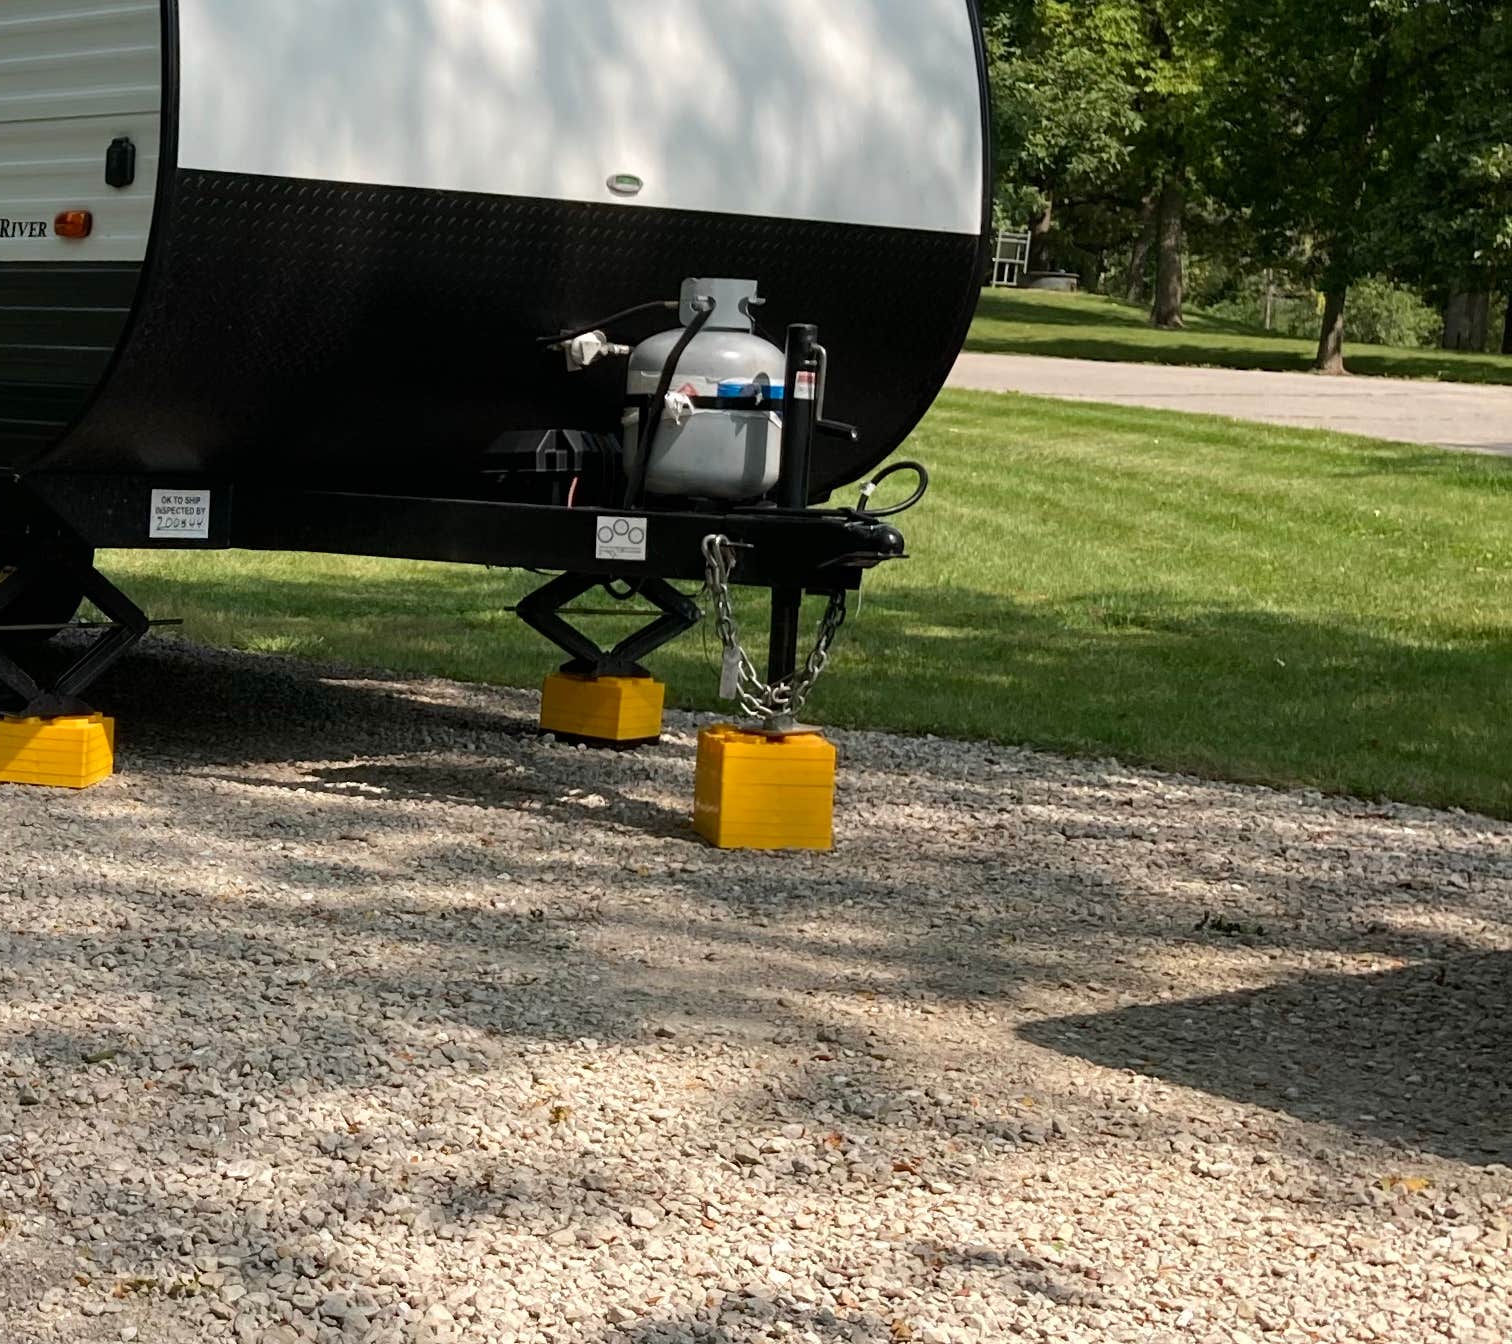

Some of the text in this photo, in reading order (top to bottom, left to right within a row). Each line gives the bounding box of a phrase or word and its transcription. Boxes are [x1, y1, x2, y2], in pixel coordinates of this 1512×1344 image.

[161, 496, 201, 505] OK TO SHIP
[155, 506, 206, 515] INSPECTED BY
